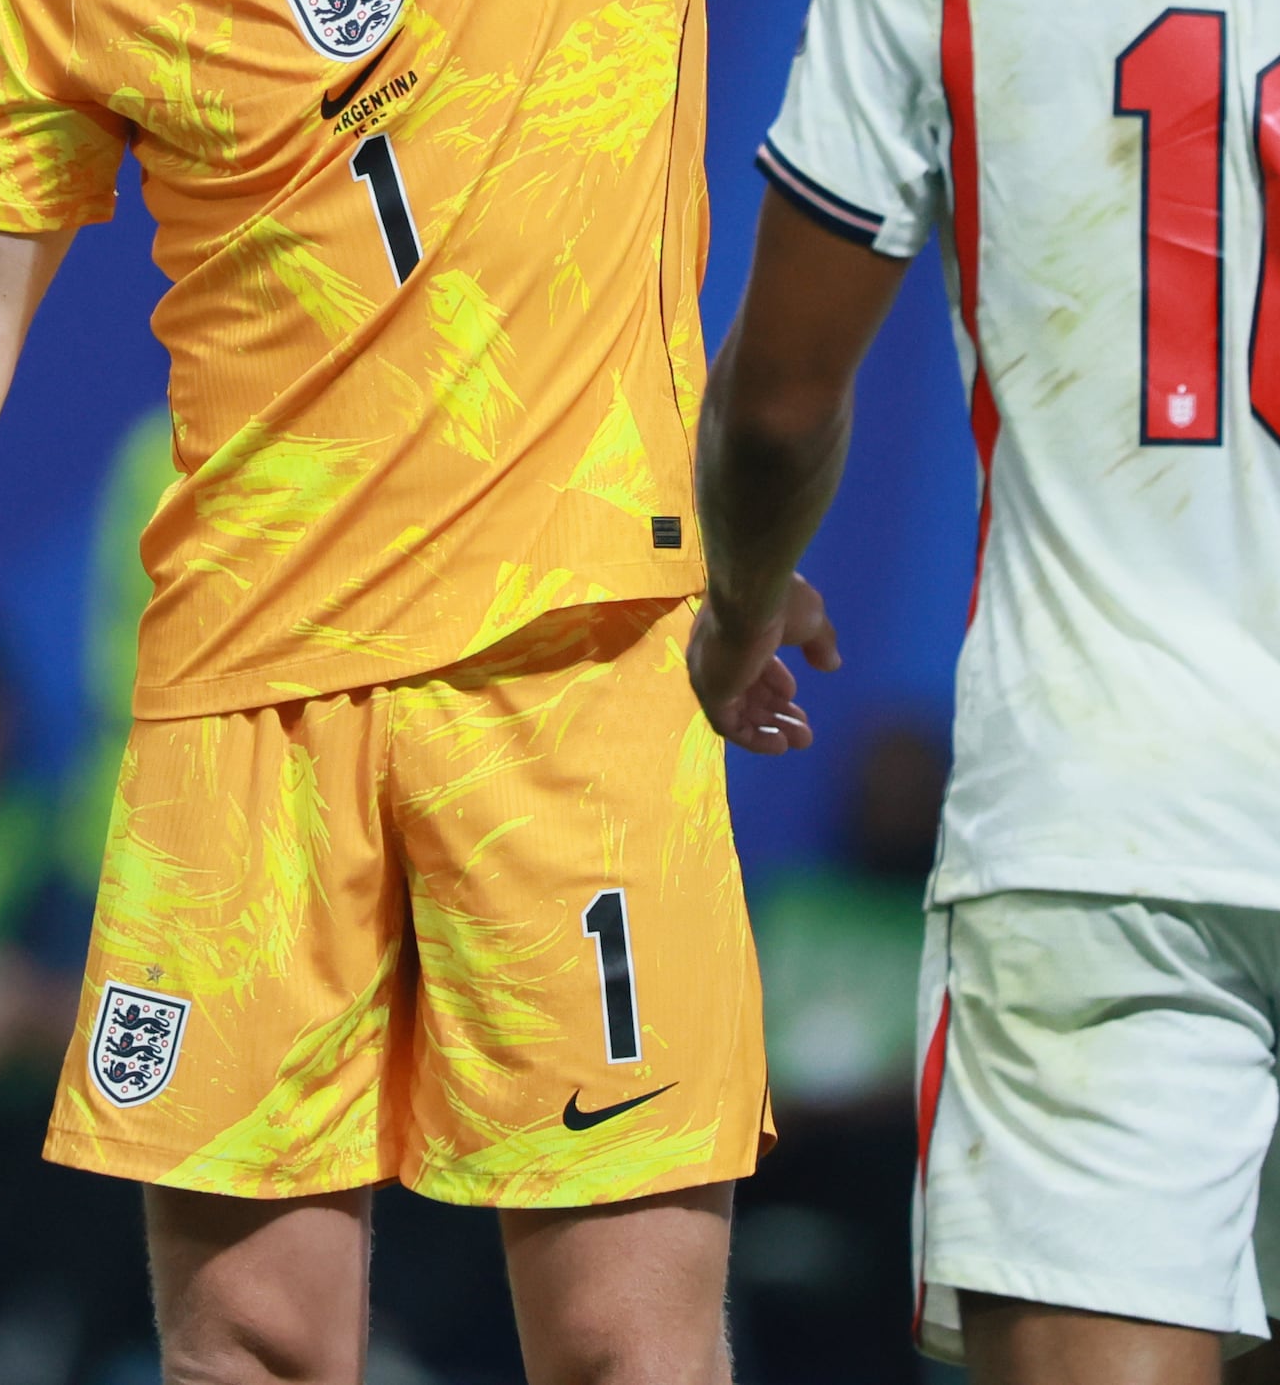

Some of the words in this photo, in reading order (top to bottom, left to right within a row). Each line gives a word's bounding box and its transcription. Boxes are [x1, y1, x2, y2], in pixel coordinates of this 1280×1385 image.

[333, 71, 419, 136] ARGENTINA
[348, 132, 425, 290] 1
[581, 887, 645, 1065] 1
